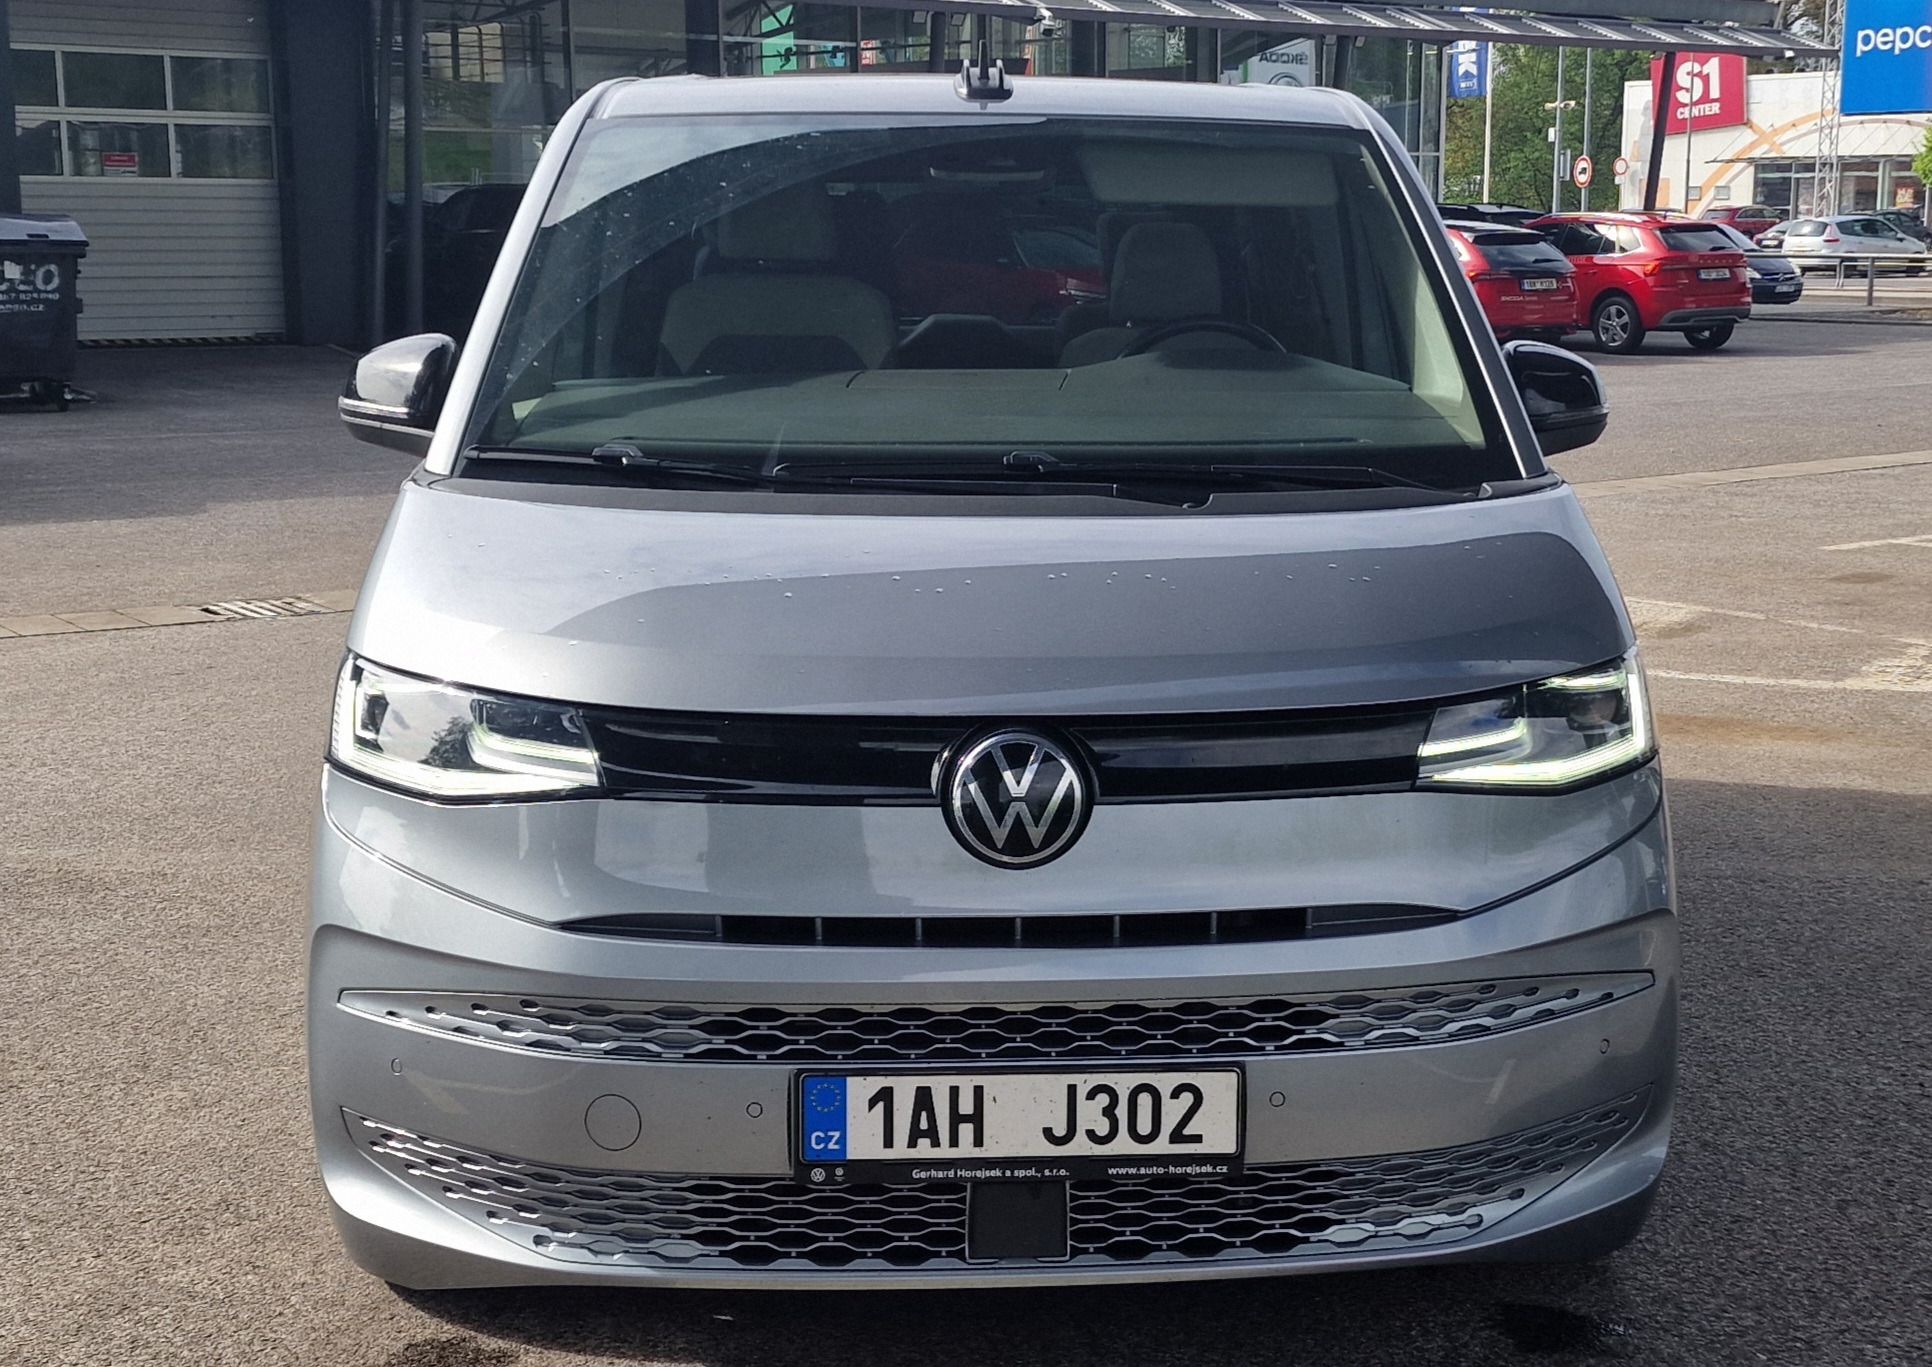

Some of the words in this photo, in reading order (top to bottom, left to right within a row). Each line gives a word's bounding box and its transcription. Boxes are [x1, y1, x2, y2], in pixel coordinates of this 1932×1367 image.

[1675, 56, 1720, 105] S1
[1676, 102, 1720, 119] CENTER
[868, 1085, 984, 1149] 1AH
[1042, 1082, 1204, 1147] J302
[811, 1131, 841, 1150] CZ
[912, 1168, 955, 1179] Gerhard
[957, 1167, 1002, 1179] Horejsek
[1004, 1169, 1011, 1177] a
[1013, 1167, 1042, 1178] spol.,
[1044, 1168, 1070, 1176] s.r.o.
[1107, 1163, 1229, 1176] www.auto-horejsek.cz
